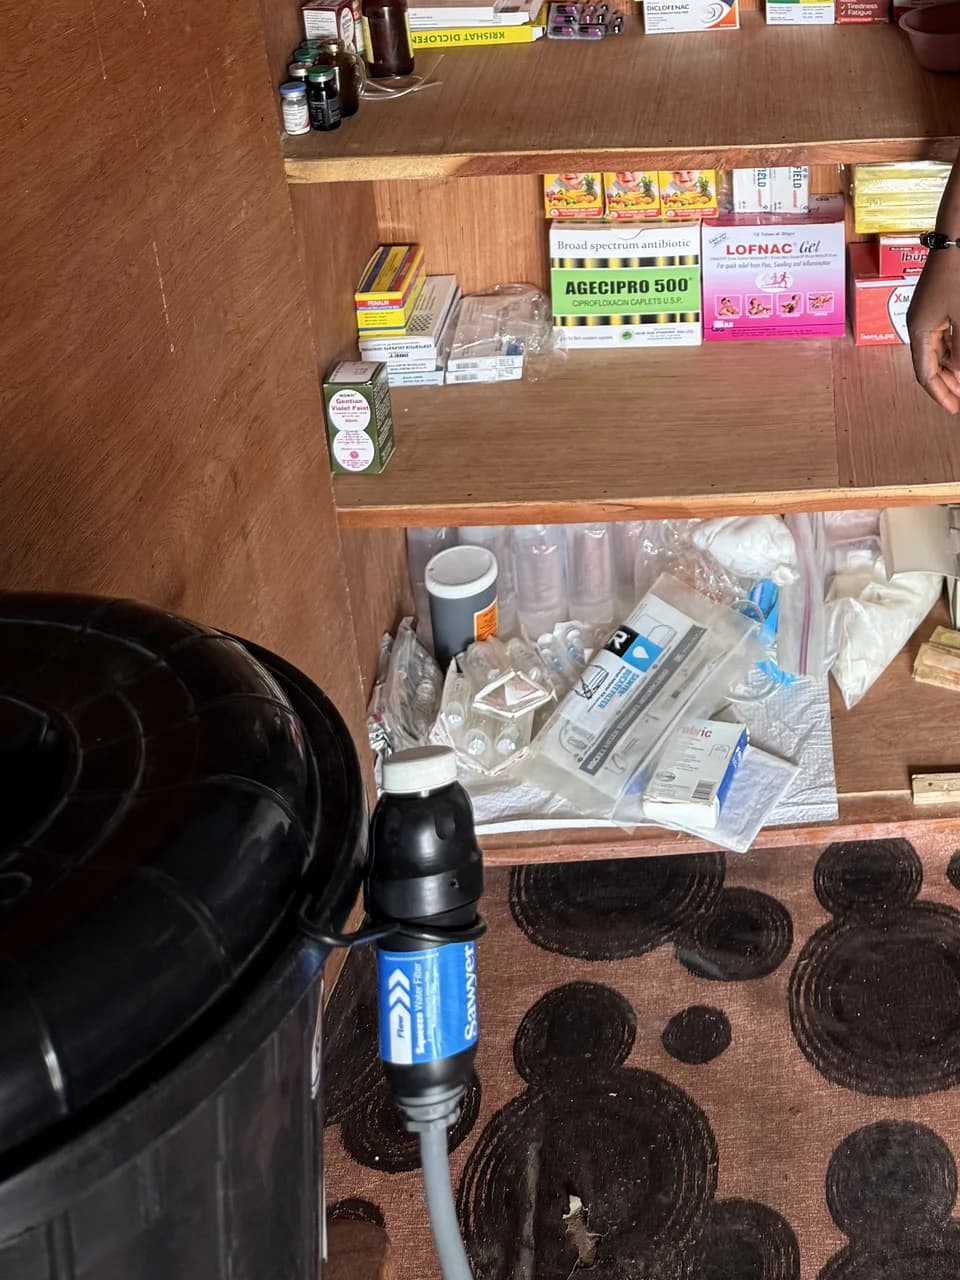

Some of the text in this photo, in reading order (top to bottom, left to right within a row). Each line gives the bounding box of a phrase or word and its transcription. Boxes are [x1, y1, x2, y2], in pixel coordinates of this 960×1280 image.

[646, 3, 690, 12] DICLOFENAC
[464, 31, 505, 40] KRISHAT
[557, 238, 692, 252] Broad spectrum antibiotic
[726, 240, 821, 256] LOFNAC Gel
[565, 278, 689, 295] AGECIPRO 500
[572, 299, 630, 308] CIPROFLOXACIN
[630, 297, 662, 306] CAPLETS
[464, 944, 478, 1041] Sawyer
[413, 962, 426, 1055] Squeeze Water Filter
[396, 1014, 405, 1039] Flow
